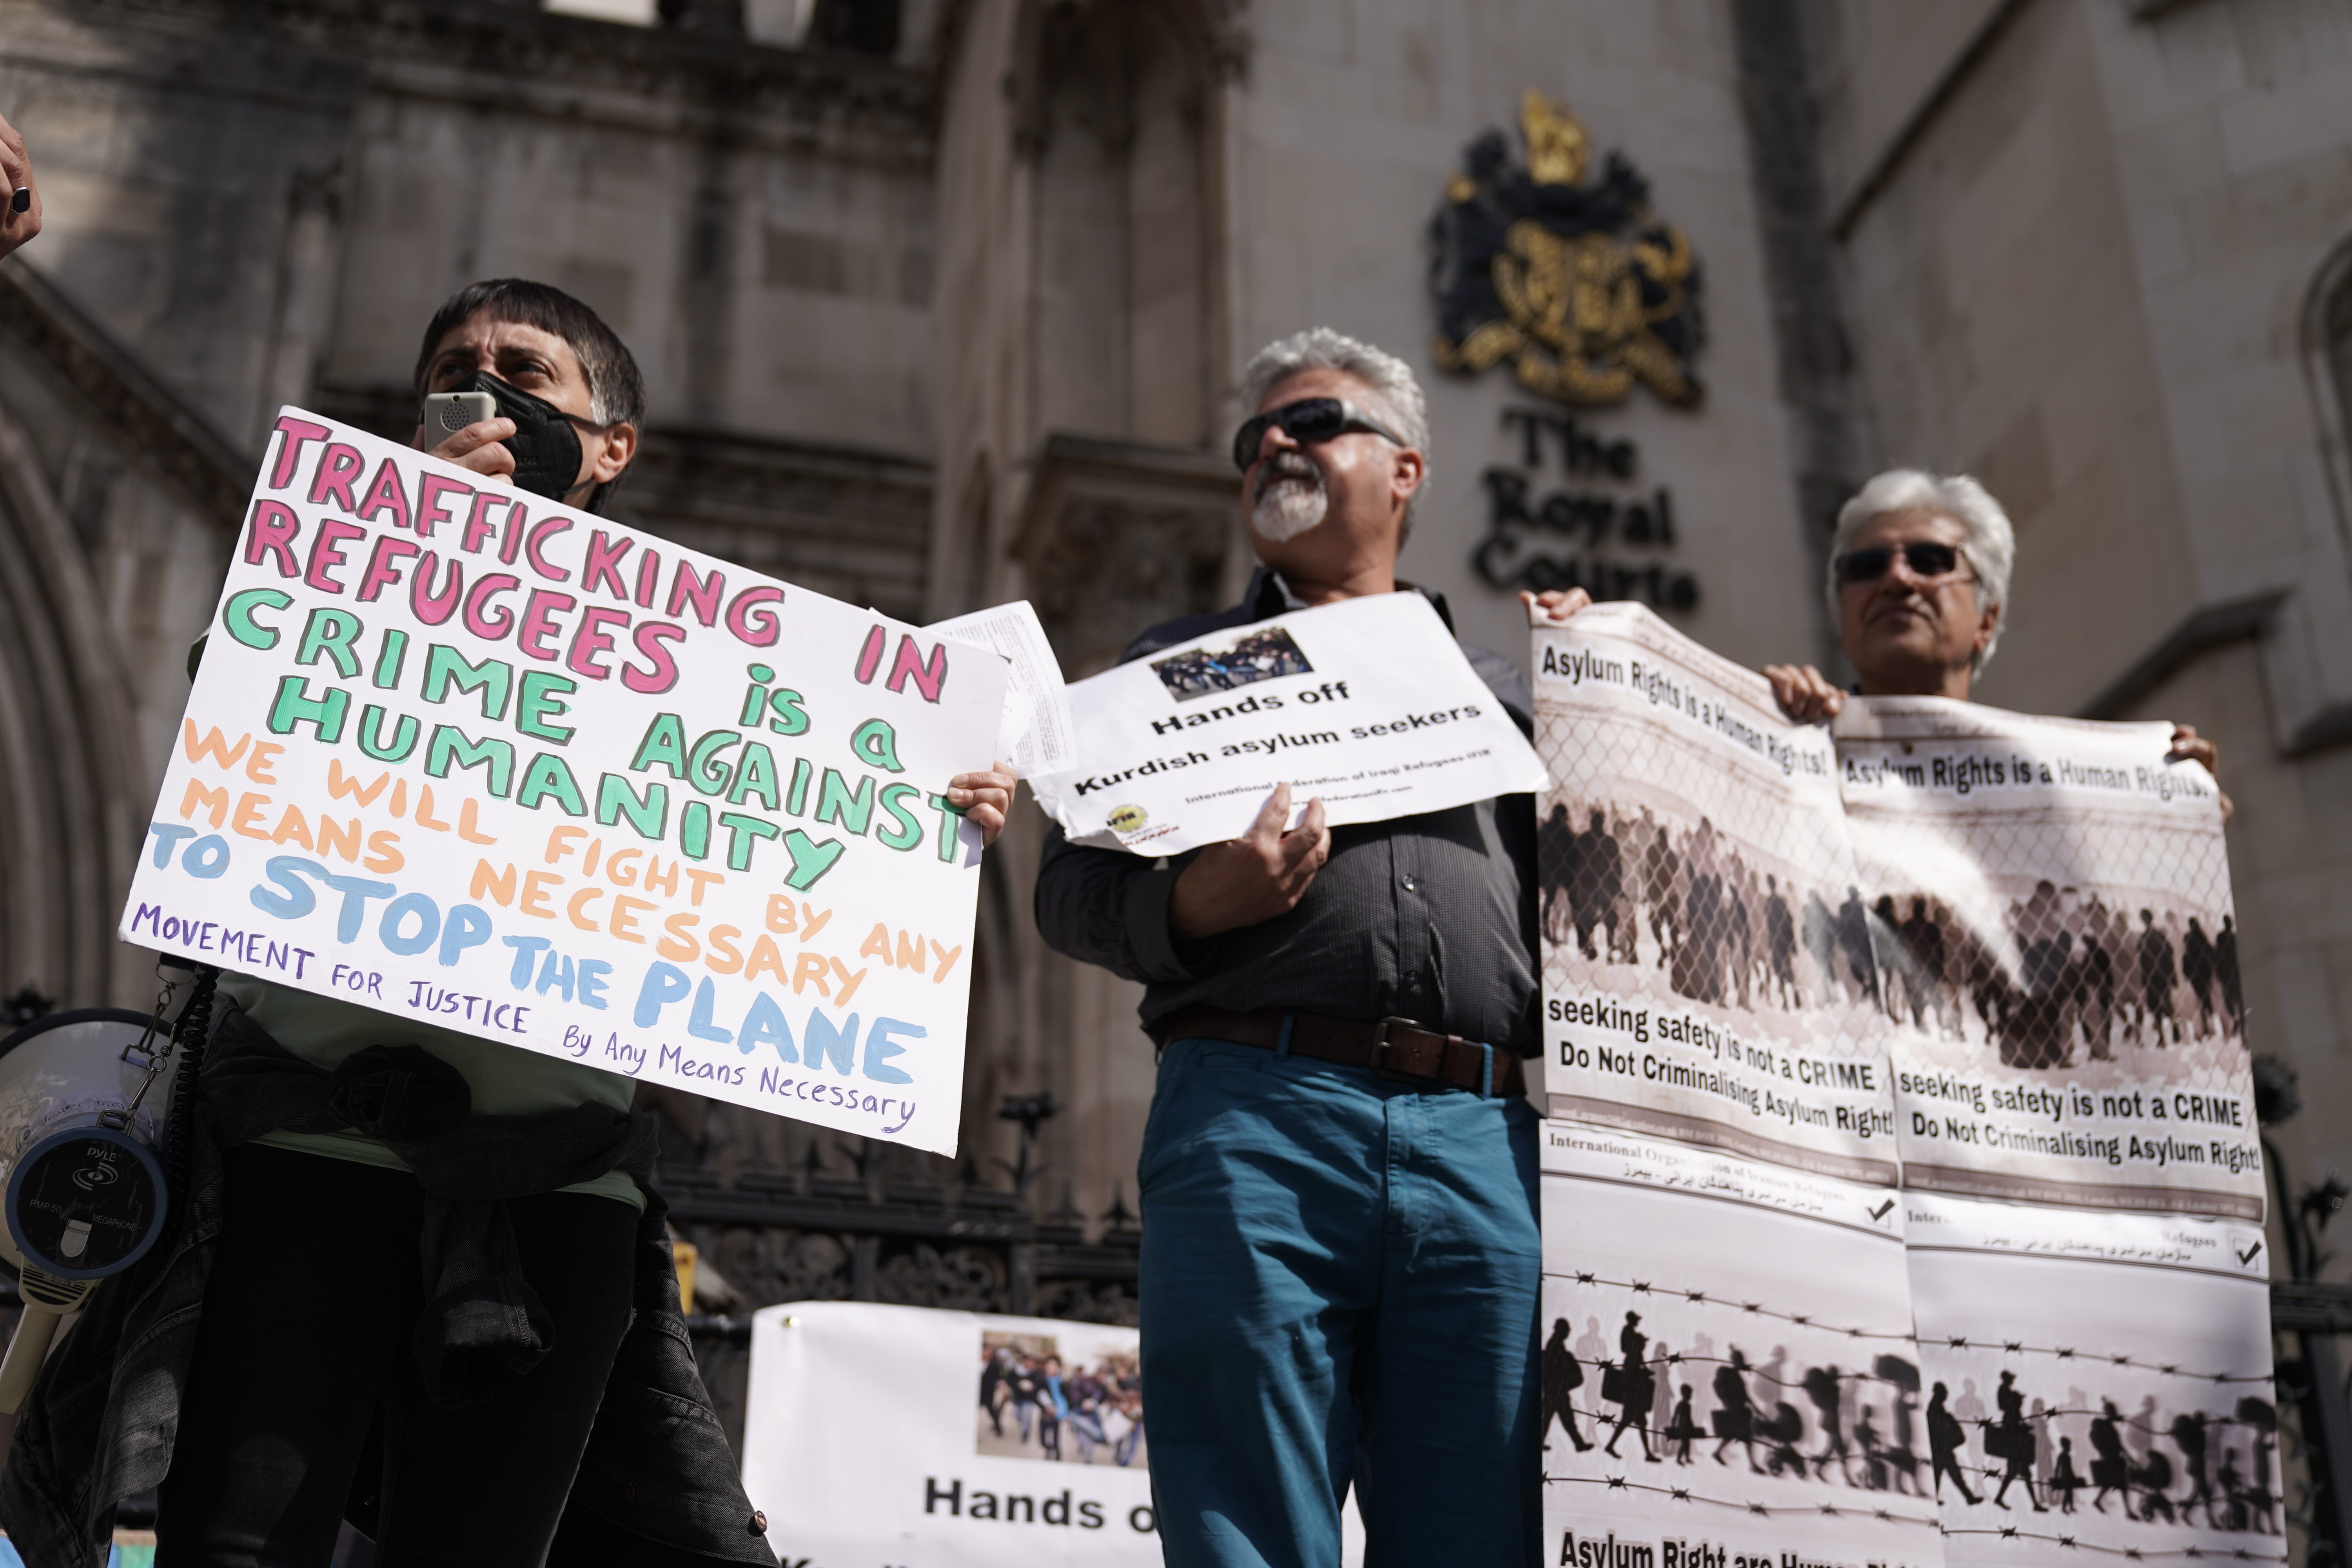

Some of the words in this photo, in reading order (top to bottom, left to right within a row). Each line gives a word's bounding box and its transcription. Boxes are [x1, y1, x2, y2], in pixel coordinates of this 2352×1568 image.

[1501, 408, 1636, 478] The
[1481, 466, 1676, 549] Royal
[269, 416, 784, 648] TRAFFICKING
[855, 624, 947, 704] IN
[244, 499, 686, 694] REFUGEES
[739, 663, 810, 736] is
[850, 718, 905, 773] a
[222, 588, 580, 746] CRIME
[628, 713, 968, 864] AGAINST
[1151, 694, 1284, 735] Hands
[1298, 681, 1351, 704] off
[1543, 646, 1624, 686] Asylum
[1632, 661, 1680, 709] Rights
[1686, 686, 1697, 718] is
[1702, 704, 1711, 726] a
[1715, 704, 1763, 754] Human
[1768, 734, 1828, 776] Rights!
[266, 675, 846, 893] HUMANITY
[1074, 750, 1210, 796] Kurdish
[1220, 730, 1340, 755] asylum
[1351, 704, 1482, 739] seekers
[1847, 758, 1925, 787] Asylum
[1933, 755, 2005, 793] Rights
[2012, 754, 2032, 784] is
[2040, 763, 2053, 783] a
[2058, 757, 2131, 789] Human
[1185, 781, 1274, 804] International
[185, 717, 285, 785] WE
[327, 758, 498, 845] WILL
[544, 825, 725, 907] FIGHT
[766, 894, 832, 943] BY
[860, 922, 962, 985] ANY
[180, 778, 405, 874] MEANS
[469, 858, 867, 1009] NECESSARY
[151, 821, 230, 879] TO
[250, 855, 493, 967] STOP
[502, 935, 614, 1010] THE
[633, 960, 928, 1085] PLANE
[131, 902, 315, 980] MOVEMENT
[331, 964, 383, 1000] FOR
[408, 980, 529, 1035] JUSTICE
[563, 1025, 592, 1057] By
[605, 1031, 646, 1076] Any
[659, 1044, 744, 1086] Means
[760, 1066, 916, 1133] Necessary
[1549, 998, 1648, 1042] seeking
[1658, 1014, 1721, 1059] safety
[1726, 1029, 1741, 1060] is
[1747, 1045, 1776, 1074] not
[1781, 1057, 1791, 1078] a
[1799, 1058, 1876, 1091] CRIME
[1560, 1040, 1590, 1068] Do
[1598, 1046, 1635, 1076] Not
[1644, 1054, 1761, 1115] Criminalising
[1766, 1090, 1828, 1130] Asylum
[1836, 1107, 1894, 1138] Right!
[1899, 1071, 1984, 1114] seeking
[1992, 1084, 2065, 1122] safety
[2072, 1087, 2093, 1116] is
[2102, 1094, 2142, 1118] not
[2151, 1101, 2167, 1119] a
[2174, 1094, 2243, 1127] CRIME
[87, 1147, 118, 1162] PYLE
[1550, 1133, 1642, 1158] International
[1912, 1112, 1938, 1138] Do
[1945, 1116, 1979, 1144] Not
[1985, 1124, 2122, 1164] Criminalising
[2129, 1135, 2205, 1167] Asylum
[2210, 1142, 2261, 1174] Right!
[29, 1199, 50, 1210] PMP
[51, 1204, 62, 1214] 50
[91, 1214, 137, 1231] MEGAPHONE
[925, 1477, 1104, 1528] Hands
[1561, 1532, 1653, 1568] Asylum
[1663, 1541, 1727, 1568] Right
